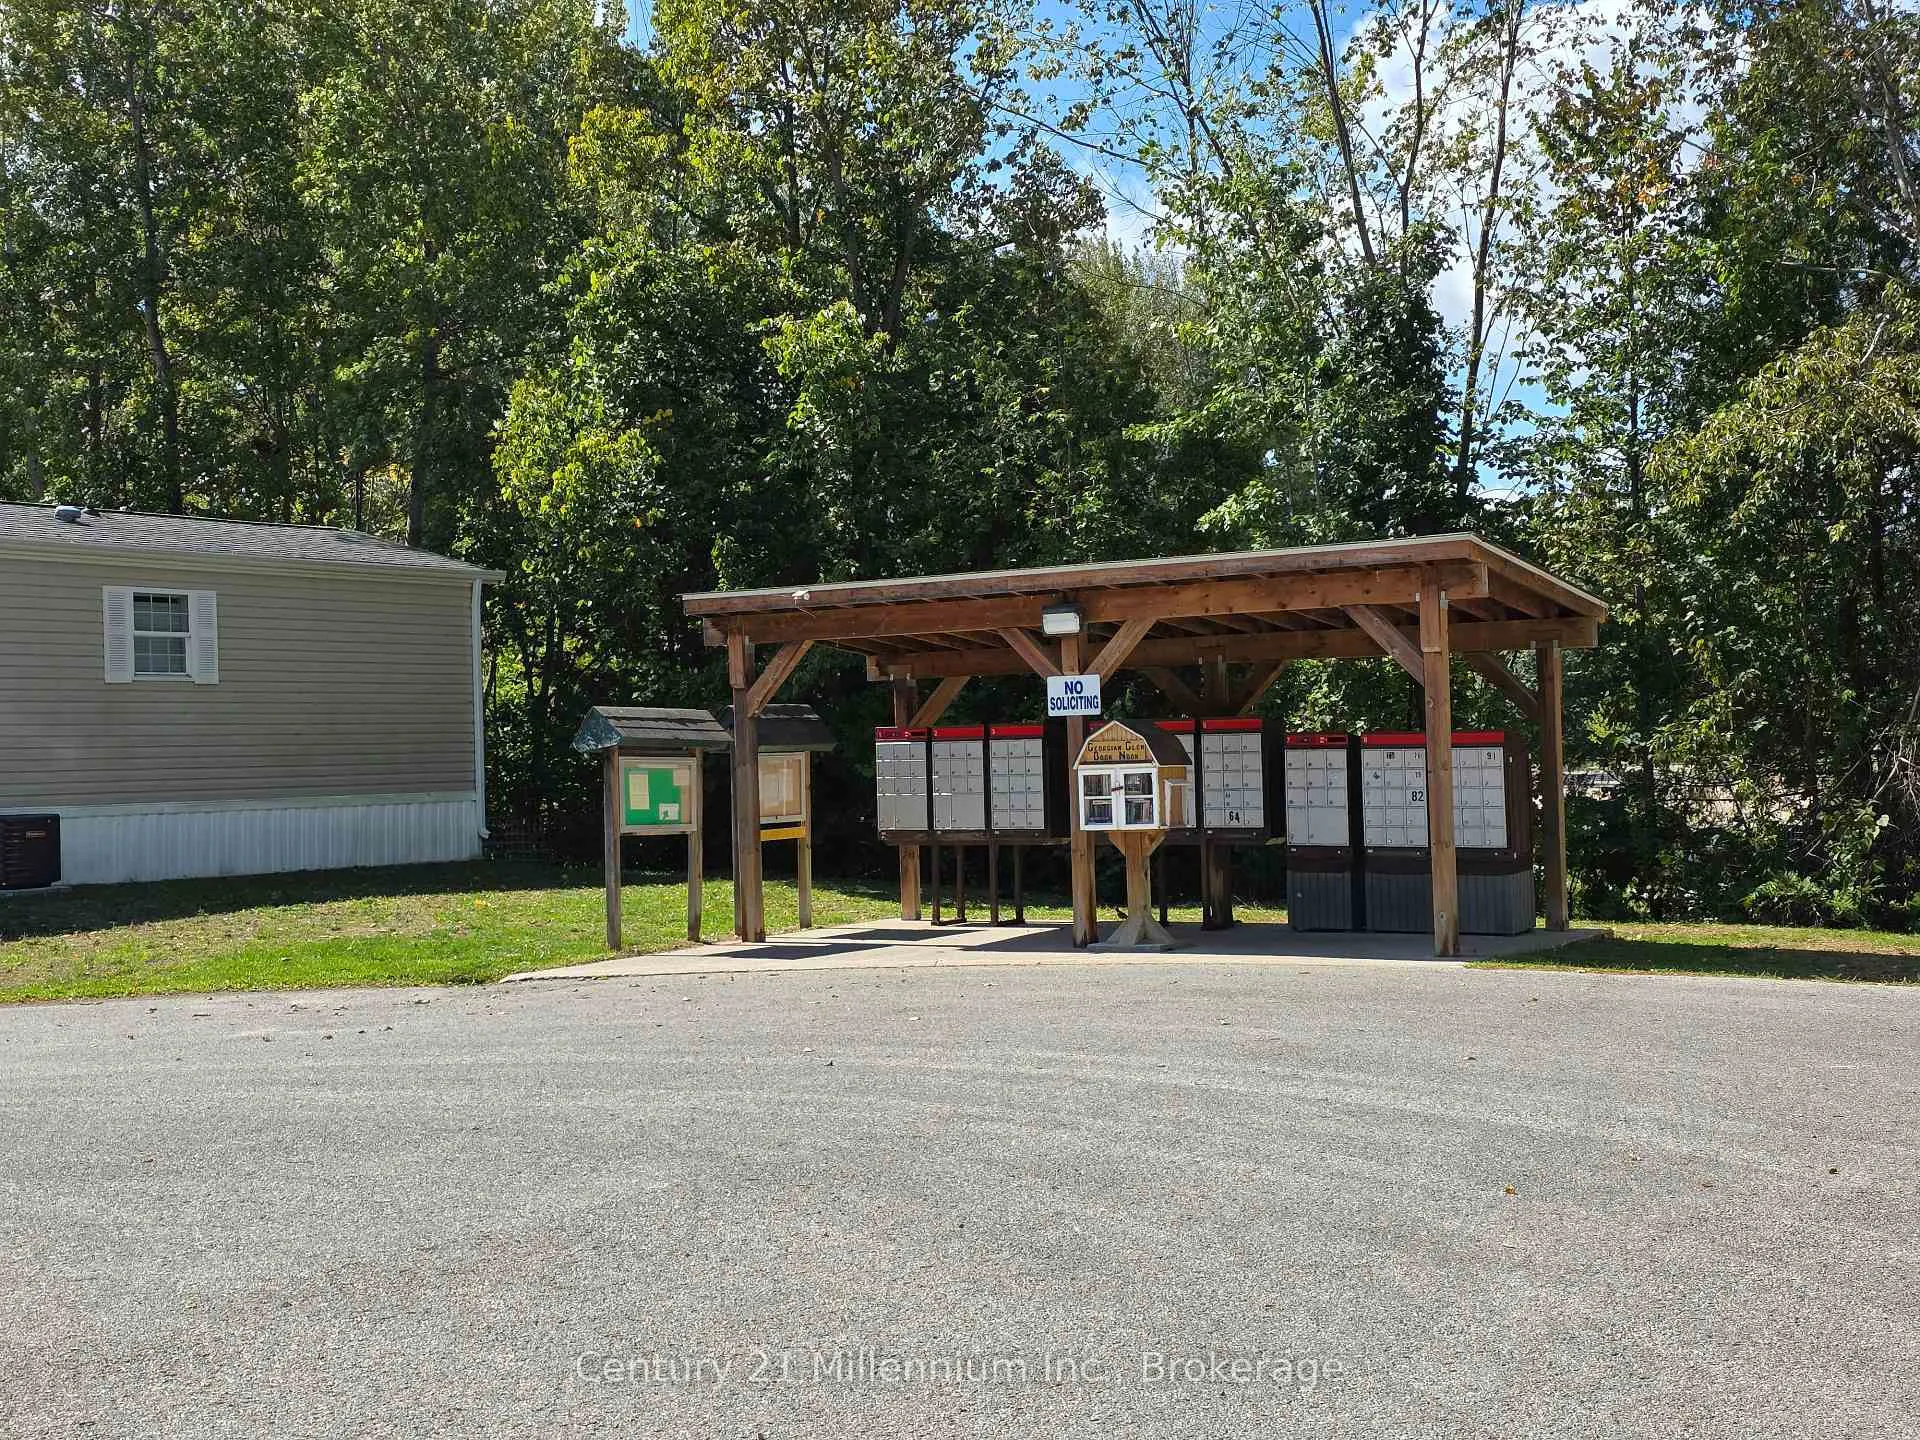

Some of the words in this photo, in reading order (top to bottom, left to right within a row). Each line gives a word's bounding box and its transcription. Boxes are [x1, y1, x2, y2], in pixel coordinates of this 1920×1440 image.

[1064, 681, 1083, 695] NO
[1050, 695, 1099, 711] SOLICITING
[1411, 791, 1424, 802] 82
[1228, 811, 1240, 824] 64
